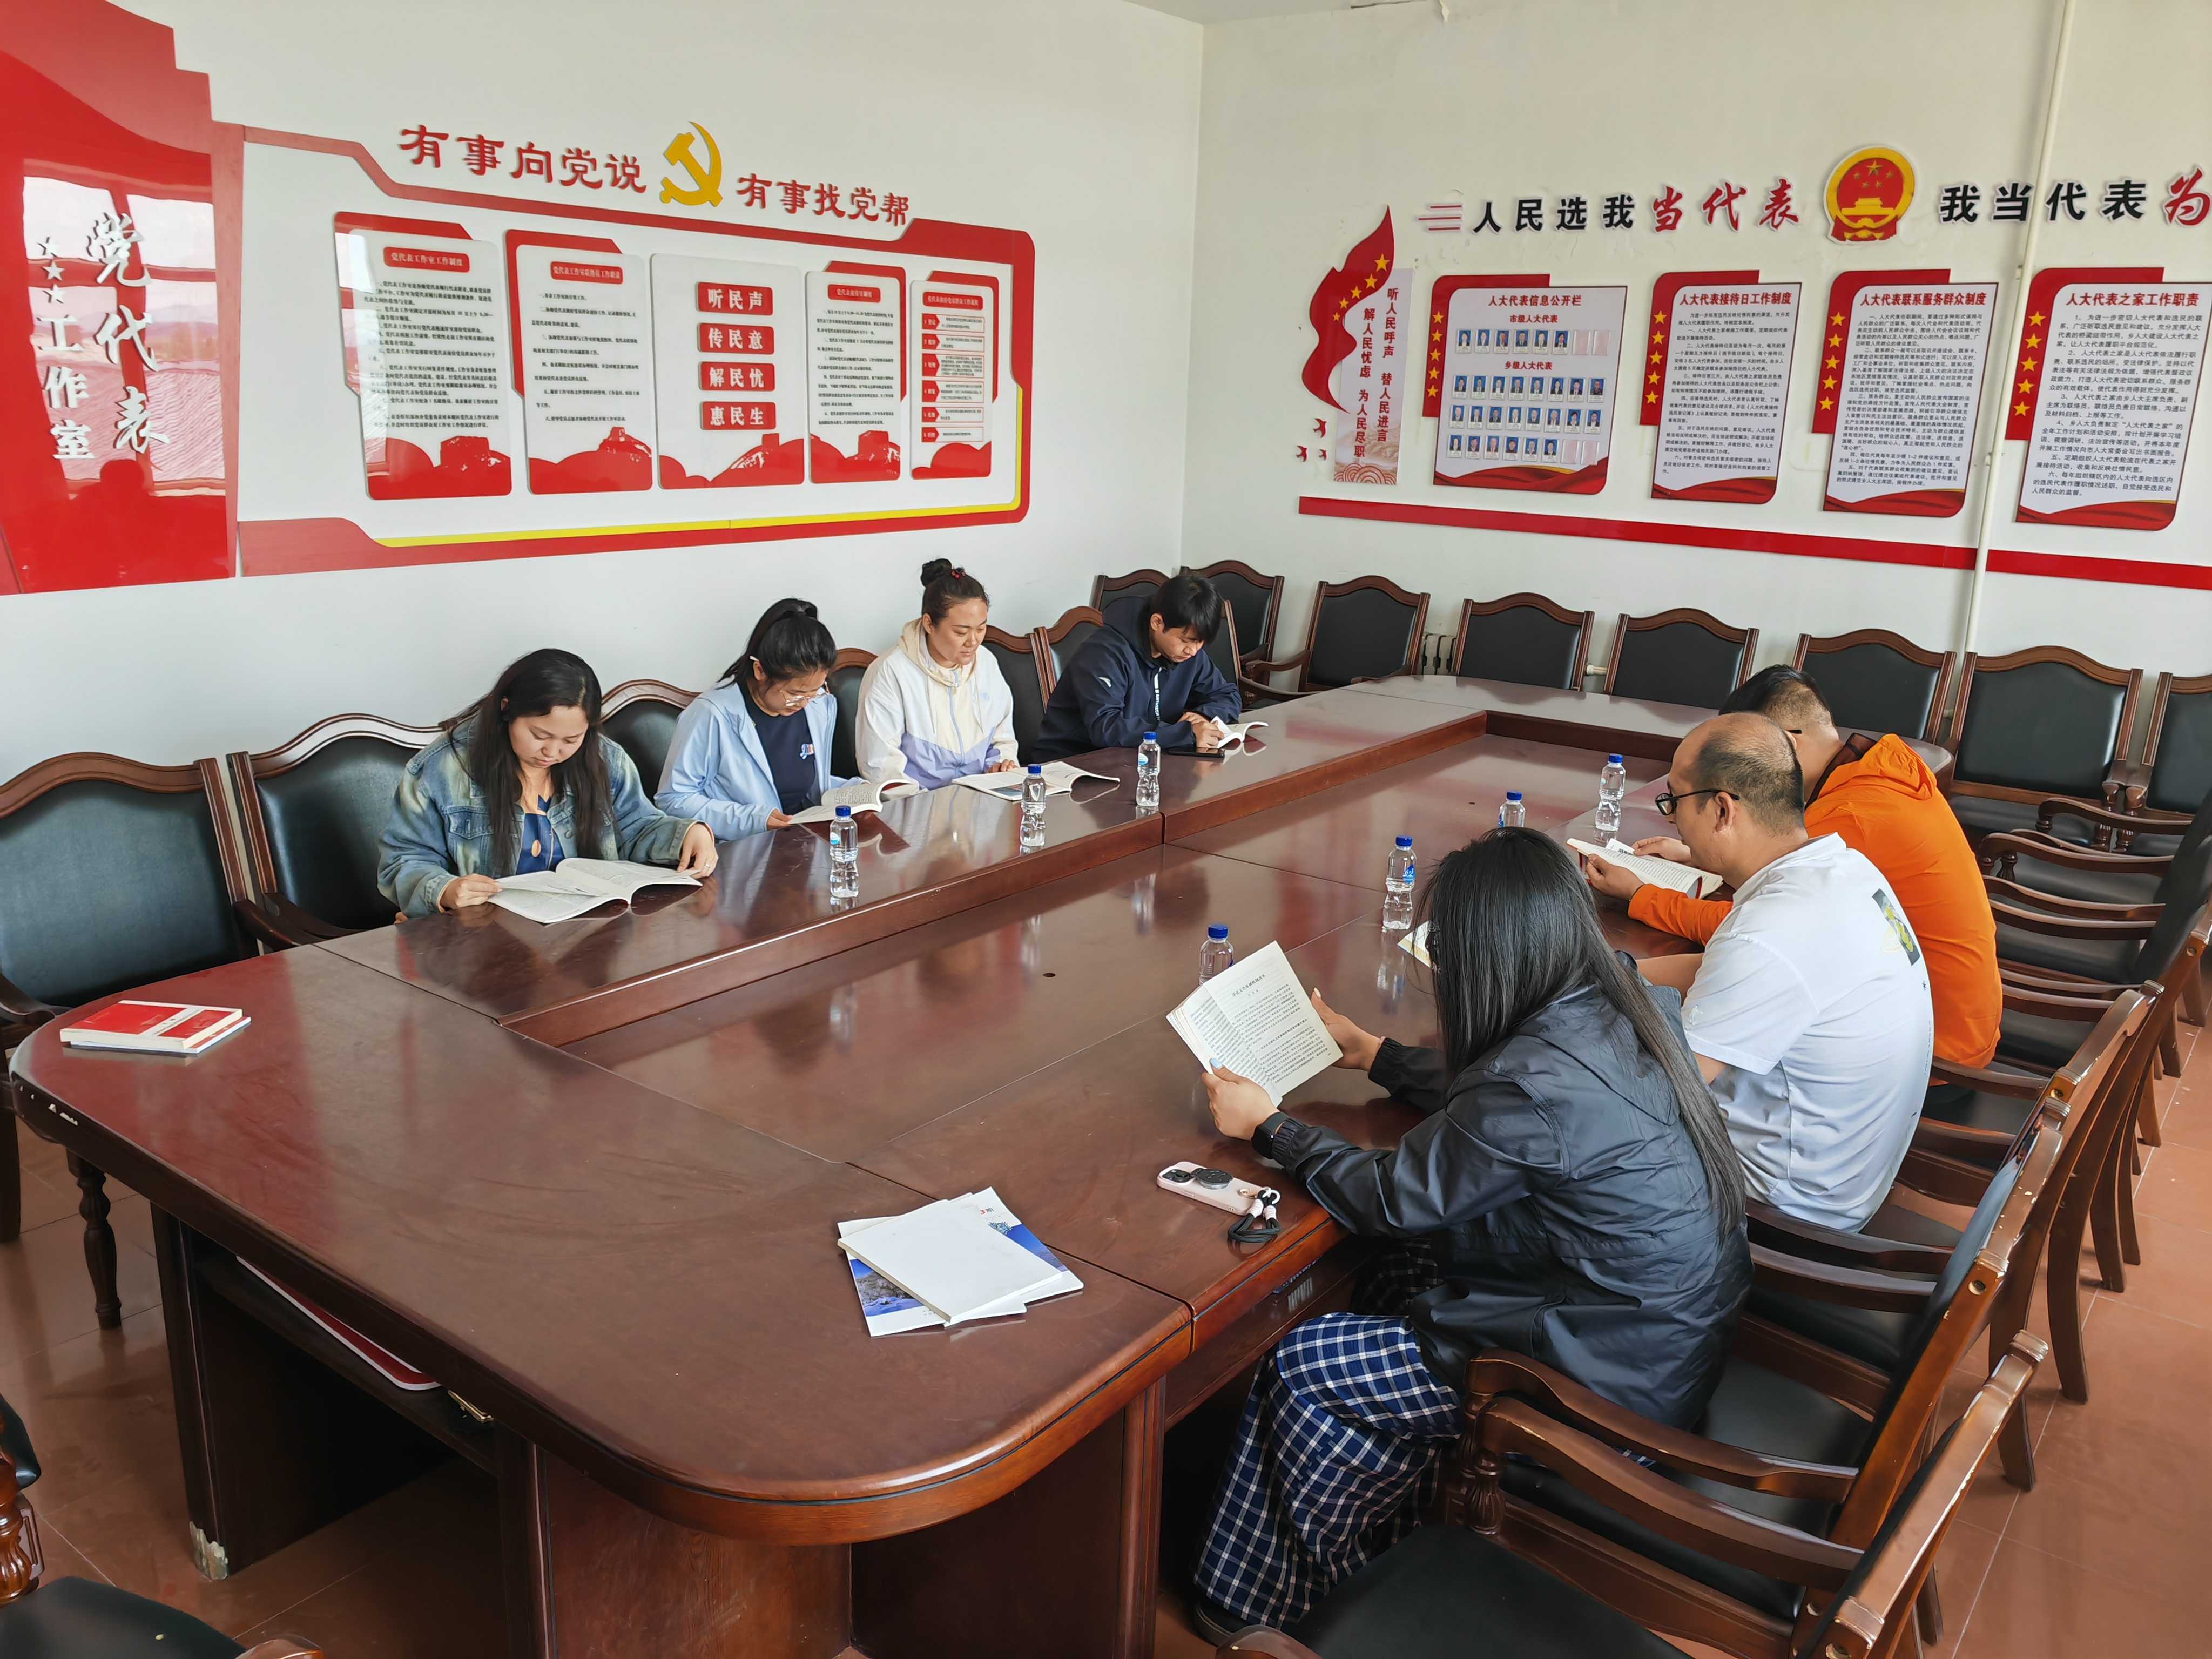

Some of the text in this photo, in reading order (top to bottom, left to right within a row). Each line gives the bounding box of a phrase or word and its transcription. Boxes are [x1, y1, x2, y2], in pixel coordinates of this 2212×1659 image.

[399, 124, 646, 193] 有事向党说
[736, 172, 909, 227] 有事找党帮
[1473, 179, 1799, 233] 人民选我当代表
[707, 289, 763, 310] 听民声
[1488, 295, 1582, 307] 人大代表信息公开栏
[1680, 292, 1792, 305] 人大代表接待日工作制度
[1860, 293, 1987, 306] 人大代表联系服务群众制度
[2066, 293, 2199, 307] 人大代表之家工作职责
[1510, 314, 1558, 323] 市级人大代表
[86, 212, 170, 453] 党代表
[708, 328, 763, 349] 传民意
[1377, 288, 1399, 442] 听人民呼声 替人民进言
[1505, 362, 1552, 370] 乡级人大代表
[37, 314, 95, 461] 工作室
[709, 367, 764, 388] 解民忧
[1354, 308, 1375, 457] 解人民忧虑 为人民尽职
[710, 406, 764, 426] 惠民生
